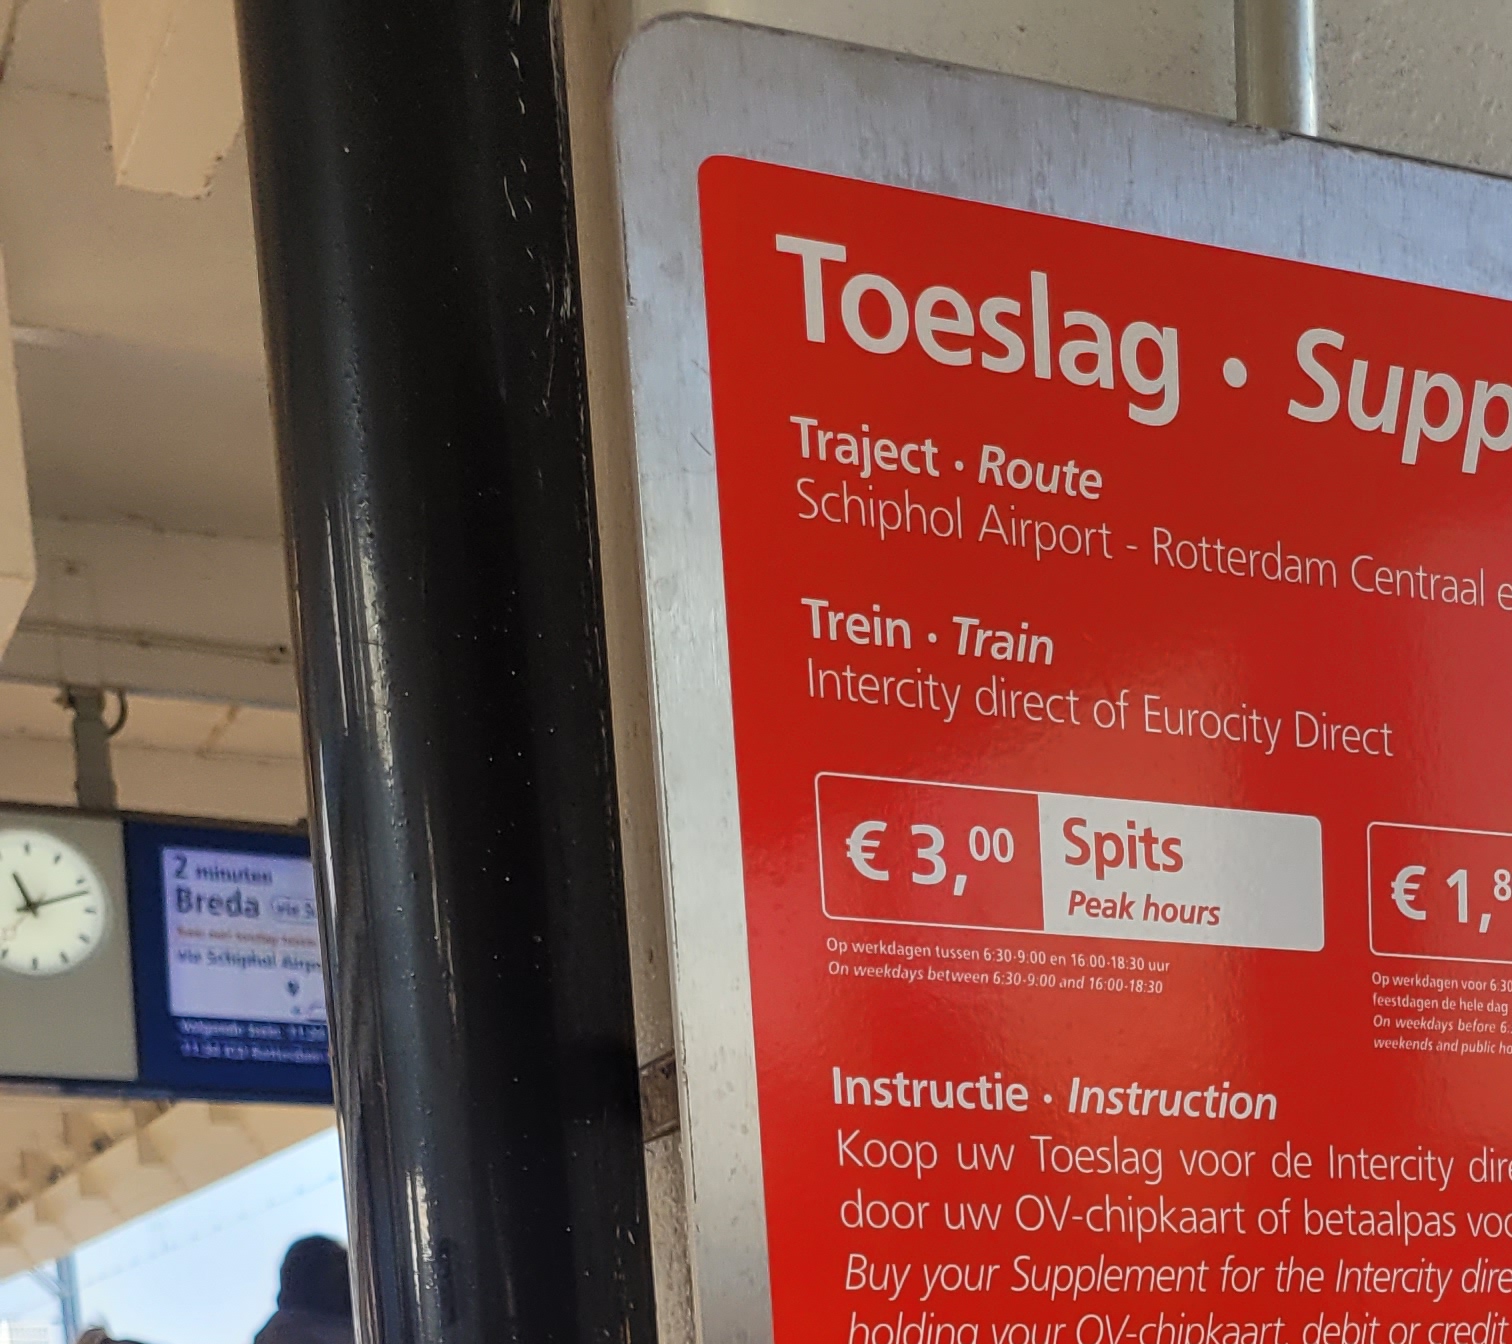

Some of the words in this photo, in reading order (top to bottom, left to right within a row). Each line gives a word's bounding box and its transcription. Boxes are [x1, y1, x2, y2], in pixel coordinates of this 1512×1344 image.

[775, 233, 1180, 427] Toeslag
[789, 415, 940, 479] Traject
[978, 444, 1103, 500] Route
[796, 477, 963, 541] Schiphol
[978, 503, 1113, 561] Airport
[1153, 526, 1337, 588] Rotterdam
[1351, 555, 1485, 607] Centraal
[800, 597, 912, 649] Trein
[952, 615, 1054, 665] Train
[807, 657, 961, 723] Intercity
[975, 674, 1081, 726] direct
[1093, 689, 1129, 730] of
[1144, 694, 1282, 755] Eurocity
[1295, 710, 1394, 757] Direct
[1062, 817, 1184, 881] Spits
[175, 887, 260, 918] Breda
[1068, 890, 1136, 921] Peak
[1142, 893, 1221, 926] hours
[826, 937, 848, 957] Op
[851, 940, 932, 960] werkdagen
[935, 945, 980, 961] tussen
[1050, 954, 1066, 966] en
[1148, 959, 1170, 972] uur
[828, 961, 849, 977] On
[853, 963, 924, 985] weekdays
[927, 967, 989, 985] between
[1059, 975, 1084, 990] and
[1371, 971, 1390, 987] Op
[1391, 973, 1459, 992] werkdagen
[1461, 979, 1487, 991] voor
[1372, 992, 1439, 1012] feestdagen
[1441, 996, 1457, 1010] de
[1459, 997, 1484, 1012] hele
[1486, 999, 1509, 1017] dag
[1373, 1014, 1390, 1028] On
[1395, 1016, 1454, 1034] weekdays
[1457, 1018, 1496, 1034] before
[1373, 1037, 1433, 1052] weekends
[1436, 1038, 1458, 1052] and
[1460, 1040, 1496, 1056] public
[832, 1066, 1029, 1112] Instructie
[1068, 1076, 1277, 1121] Instruction
[837, 1128, 938, 1180] Koop
[957, 1142, 1015, 1171] uw
[1029, 1135, 1163, 1186] Toeslag
[1179, 1149, 1256, 1177] voor
[1271, 1140, 1313, 1179] de
[1329, 1144, 1455, 1192] Intercity
[840, 1187, 930, 1229] door
[944, 1202, 1002, 1231] uw
[1015, 1193, 1246, 1243] OV-chipkaart
[1257, 1197, 1291, 1235] of
[1304, 1197, 1457, 1247] betaalpas
[845, 1253, 912, 1302] Buy
[919, 1263, 1001, 1302] your
[1010, 1253, 1210, 1302] Supplement
[1220, 1254, 1266, 1293] for
[1275, 1255, 1325, 1293] the
[1335, 1258, 1453, 1303] Intercity
